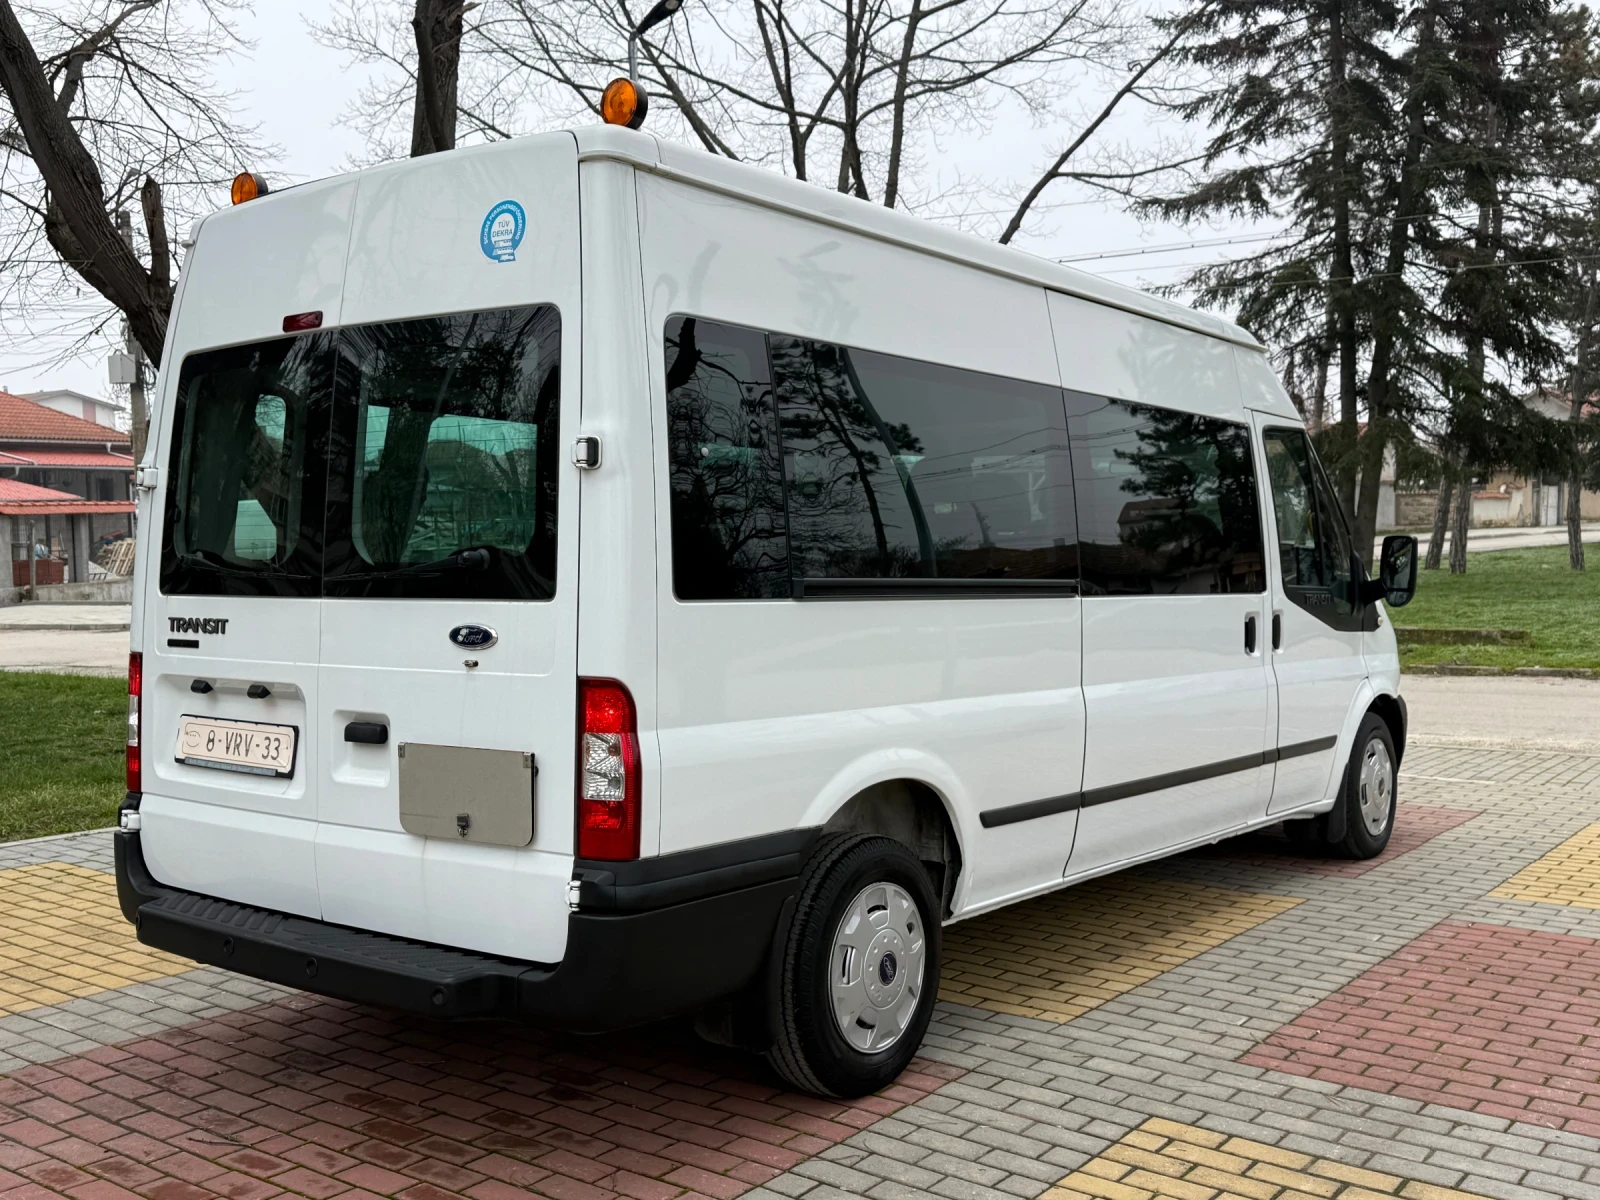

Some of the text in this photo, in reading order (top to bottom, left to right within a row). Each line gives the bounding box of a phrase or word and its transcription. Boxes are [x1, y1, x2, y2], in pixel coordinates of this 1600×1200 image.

[498, 220, 510, 228] TÜV
[492, 229, 513, 237] DEKRA
[168, 617, 229, 635] TRANSIT
[456, 628, 484, 643] Ford
[206, 729, 282, 761] 8-VRV-33
